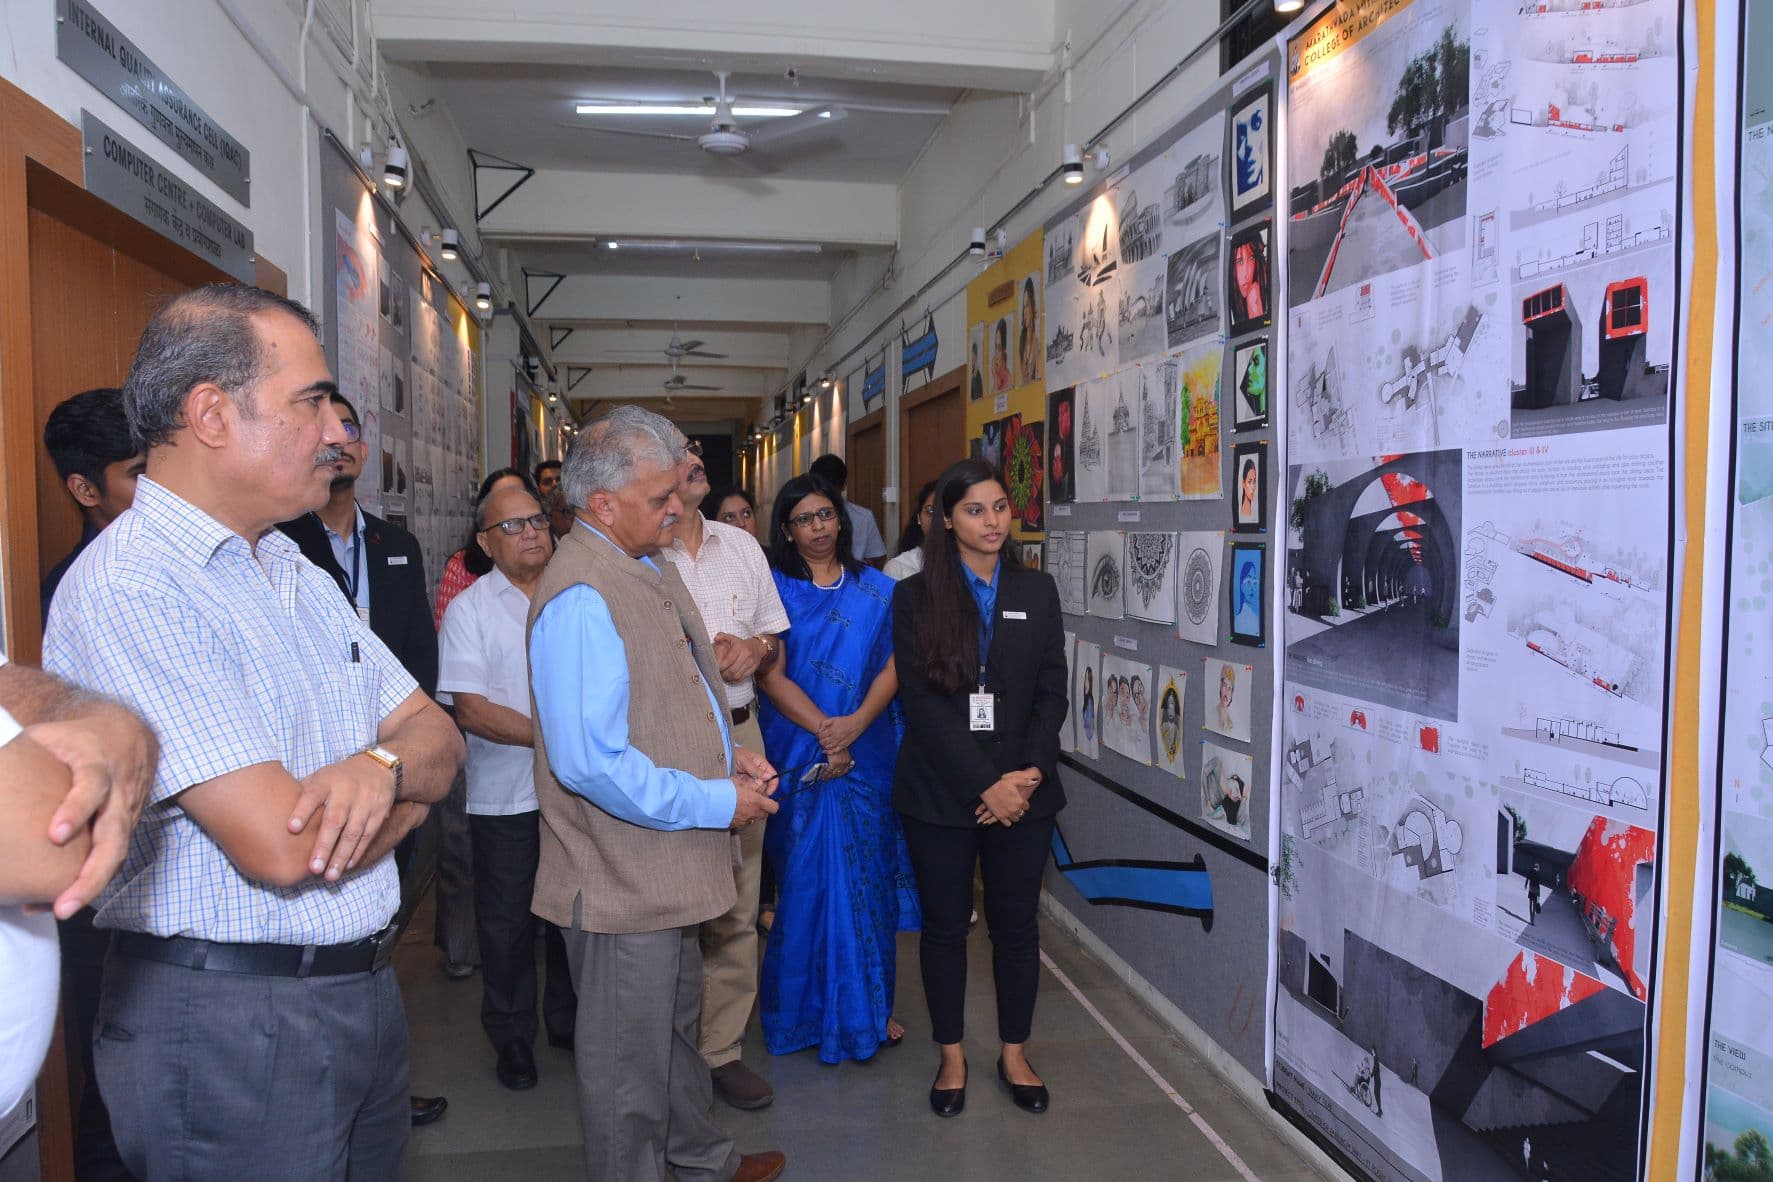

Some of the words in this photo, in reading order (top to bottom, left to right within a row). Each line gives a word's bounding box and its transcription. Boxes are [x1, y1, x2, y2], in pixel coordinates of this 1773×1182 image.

[1304, 35, 1340, 66] COLLEGE
[1342, 25, 1354, 41] OF
[68, 0, 116, 60] INTERNAL
[203, 122, 218, 150] CELL
[1748, 127, 1764, 142] THE
[103, 134, 154, 188] COMPUTER
[157, 173, 186, 209] CENTRE
[196, 200, 232, 242] COMPUTER
[1743, 422, 1757, 433] THE
[1467, 450, 1477, 460] THE
[1478, 448, 1507, 459] NARRATIVE
[1713, 1039, 1727, 1053] THE
[1728, 1046, 1746, 1061] VIEW
